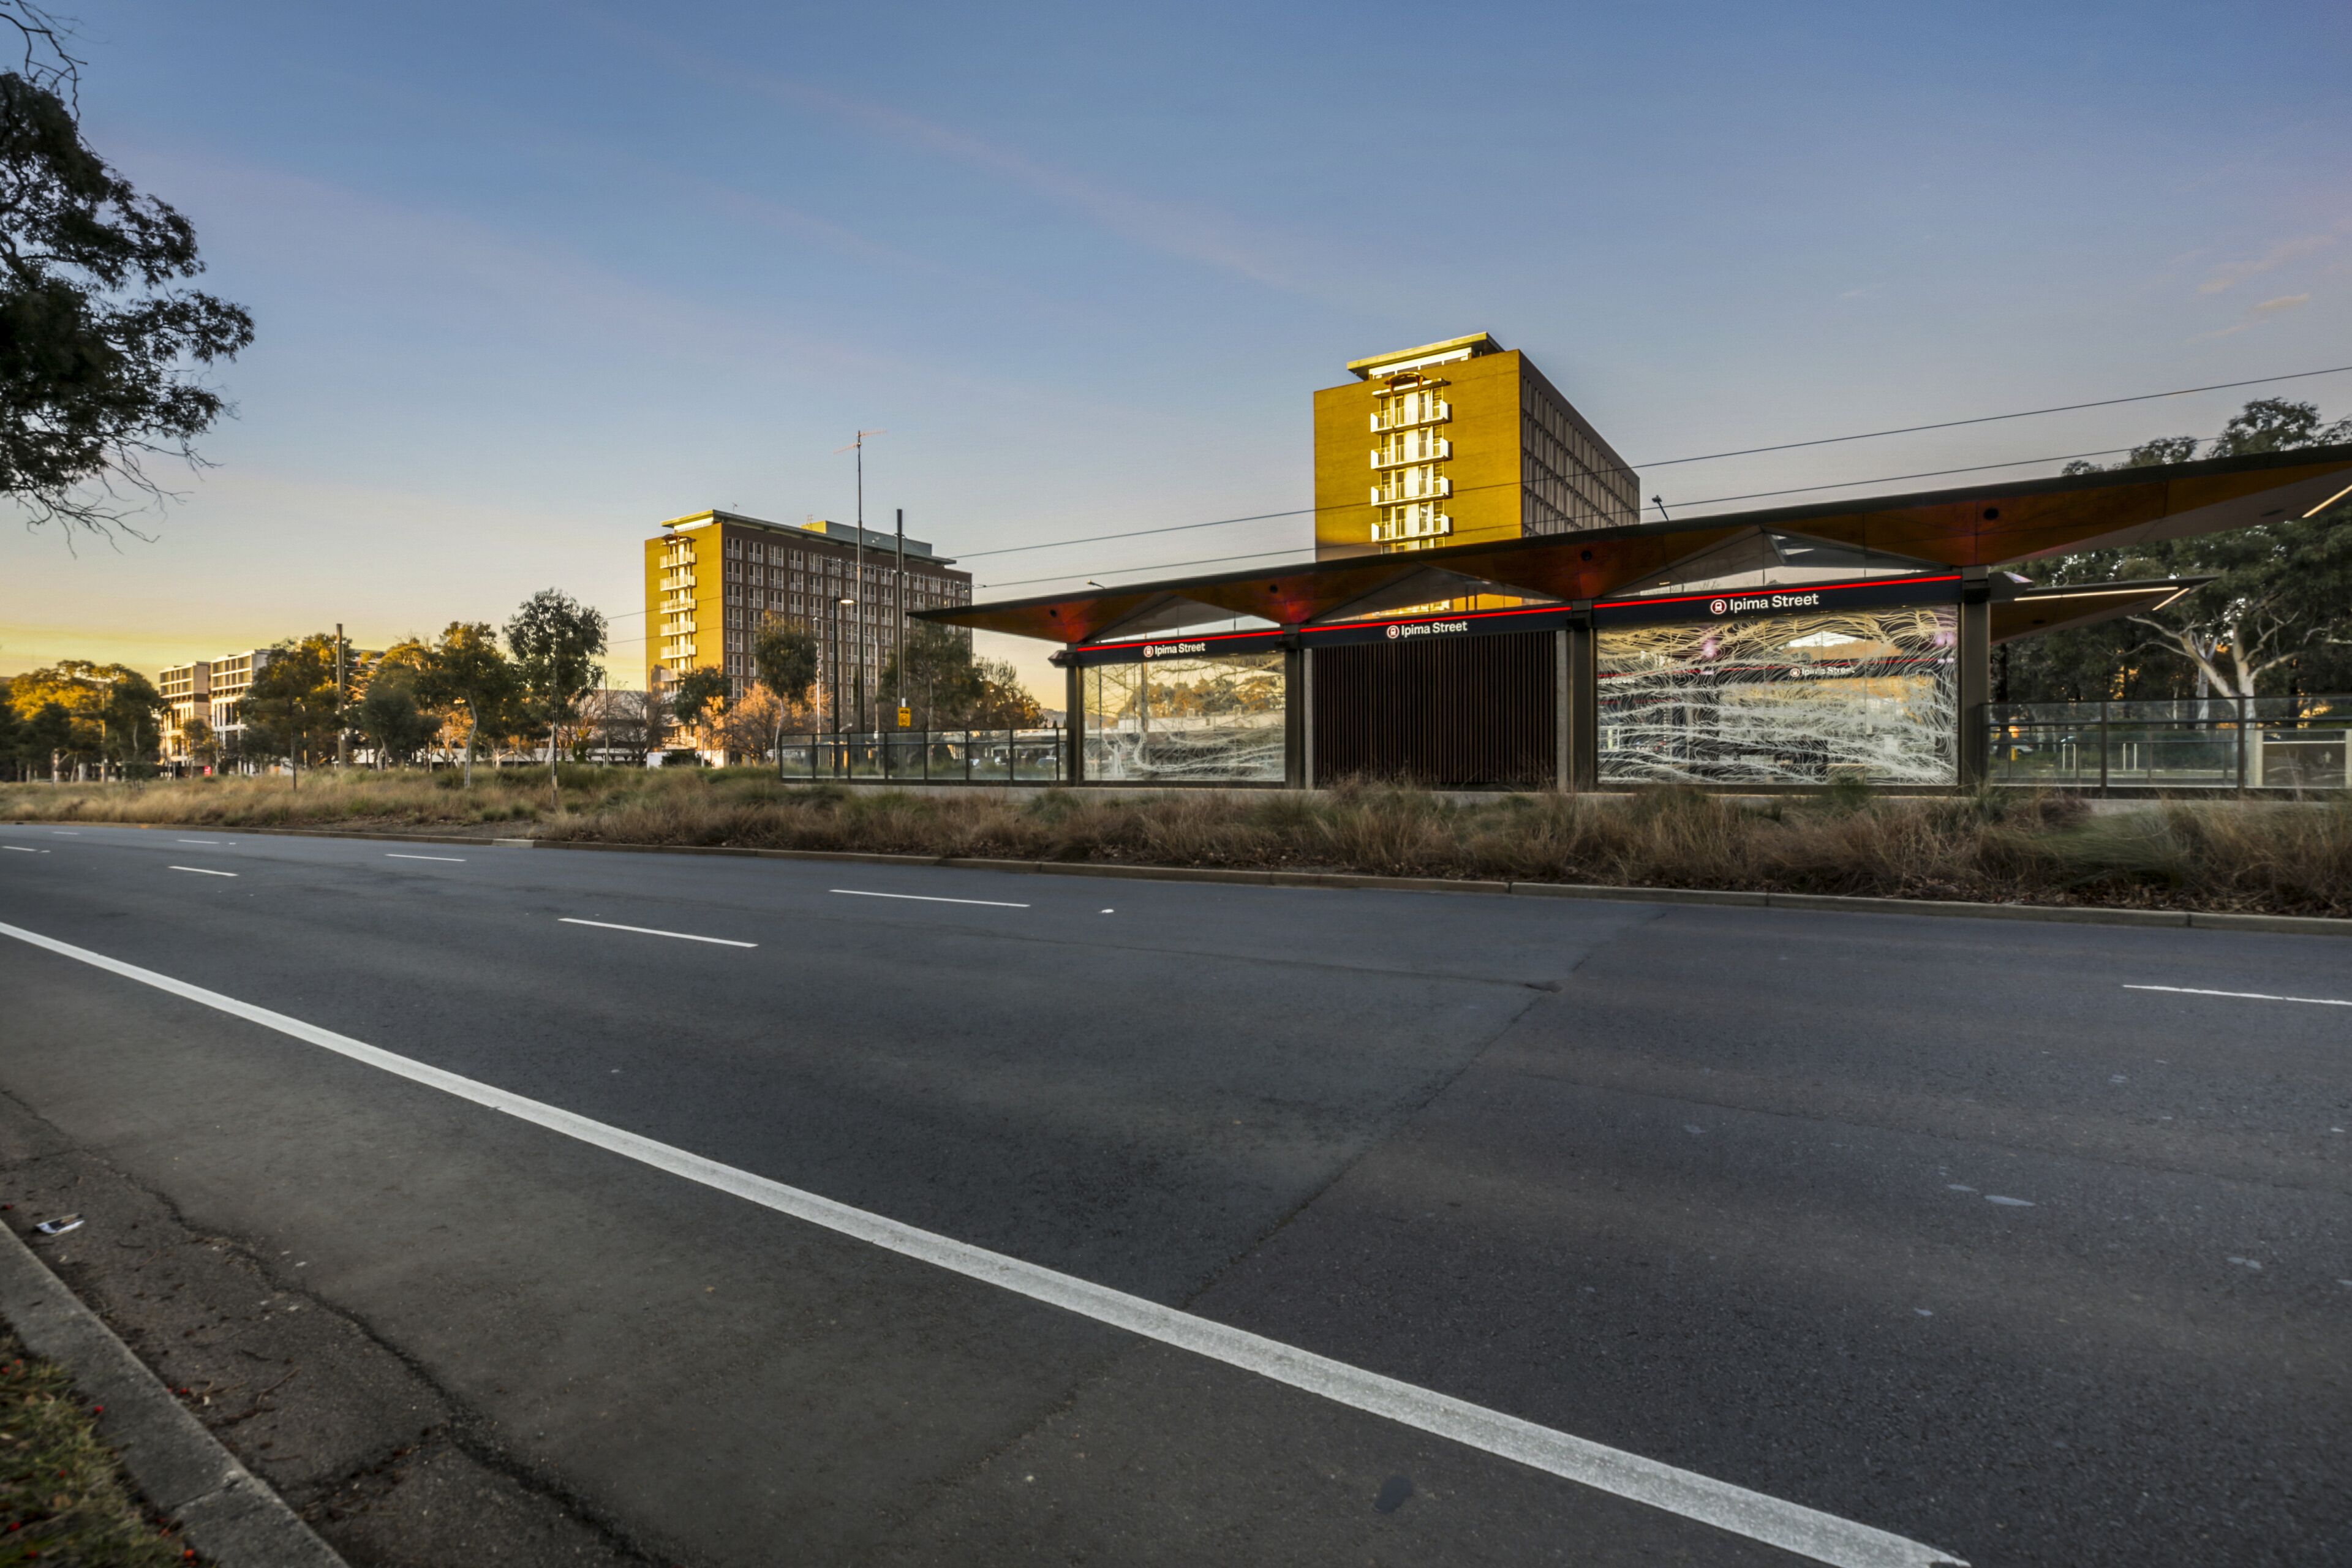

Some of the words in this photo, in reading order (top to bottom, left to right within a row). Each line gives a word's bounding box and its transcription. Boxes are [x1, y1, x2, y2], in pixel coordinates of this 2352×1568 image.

[1730, 597, 1769, 613] Ipima
[1772, 593, 1819, 608] Street
[1401, 624, 1430, 638] Ipima
[1432, 620, 1468, 633] Street
[1155, 644, 1177, 657] Ipima
[1178, 642, 1205, 653] Street
